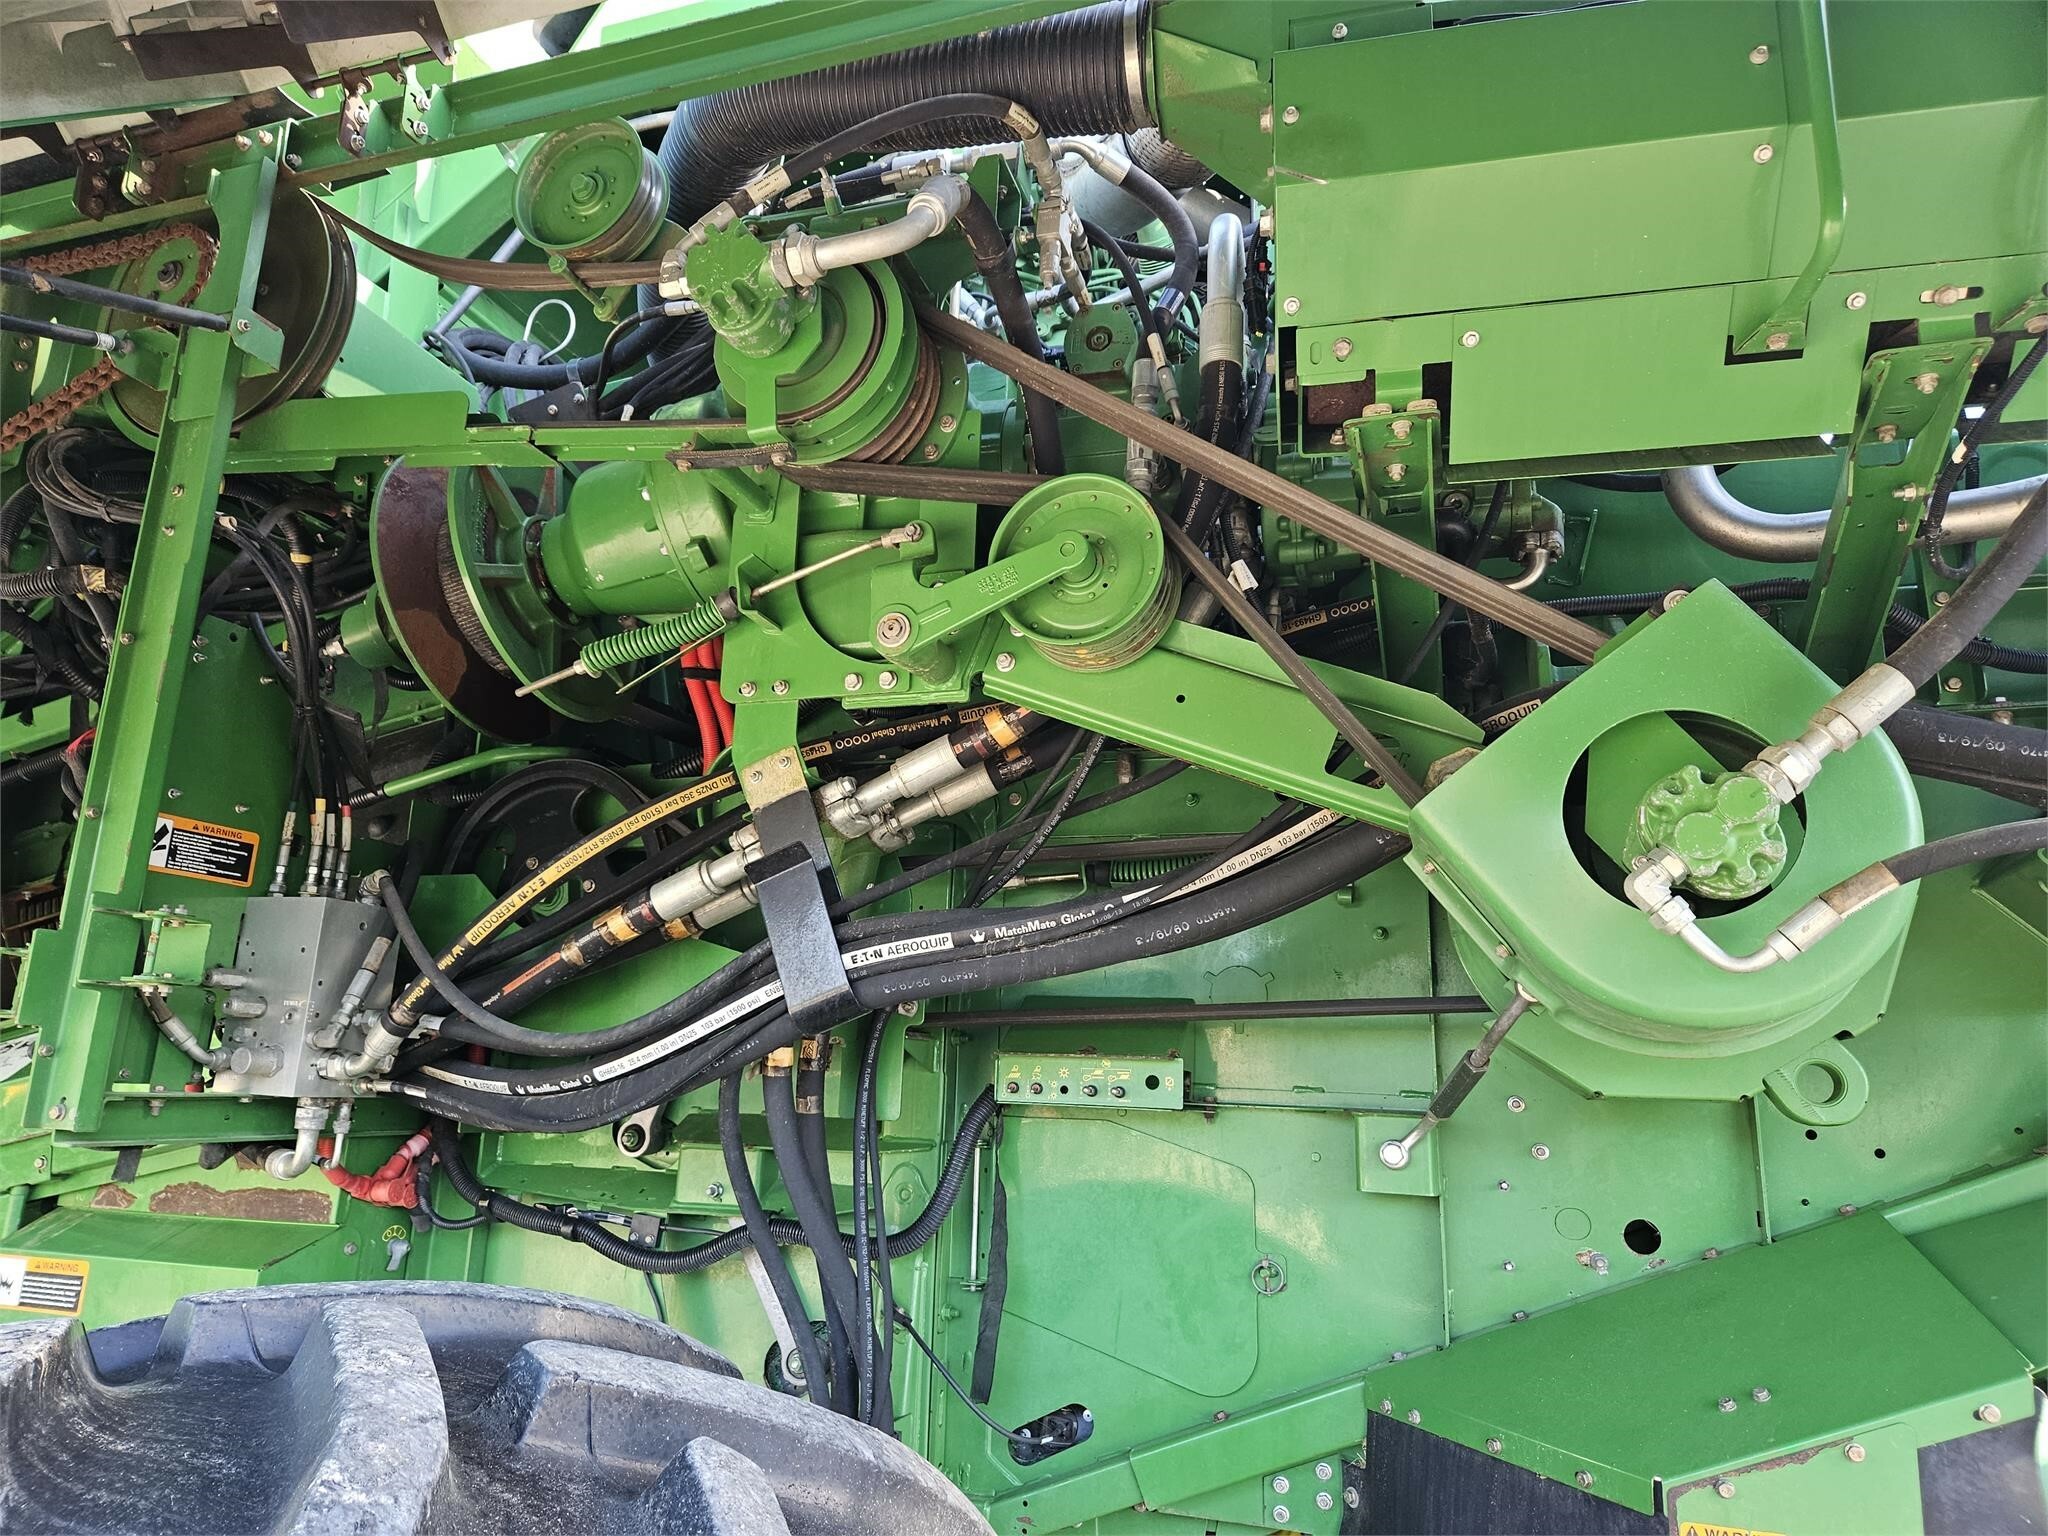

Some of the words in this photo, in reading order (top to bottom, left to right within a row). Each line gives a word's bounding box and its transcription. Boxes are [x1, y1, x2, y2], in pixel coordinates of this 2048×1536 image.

[898, 716, 940, 732] MatchMate
[871, 727, 897, 740] Global
[696, 783, 719, 797] DN25
[665, 799, 679, 810] bar
[680, 793, 695, 804] 350
[641, 808, 664, 822] (5100
[202, 824, 243, 840] WARNING
[1198, 872, 1215, 885] mm
[1237, 855, 1250, 869] in)
[1250, 846, 1273, 862] DN25
[1278, 834, 1293, 848] 103
[1293, 827, 1306, 841] bar
[1308, 815, 1329, 833] (1500
[471, 901, 516, 942] AEROQUIP
[887, 935, 950, 957] AEROQUIP
[994, 918, 1057, 939] MatchMate
[560, 1078, 583, 1089] Global
[678, 1029, 698, 1043] DN25
[701, 1020, 714, 1031] 103
[714, 1014, 727, 1025] bar
[727, 1003, 746, 1018] (1500
[42, 1261, 79, 1273] WARNING
